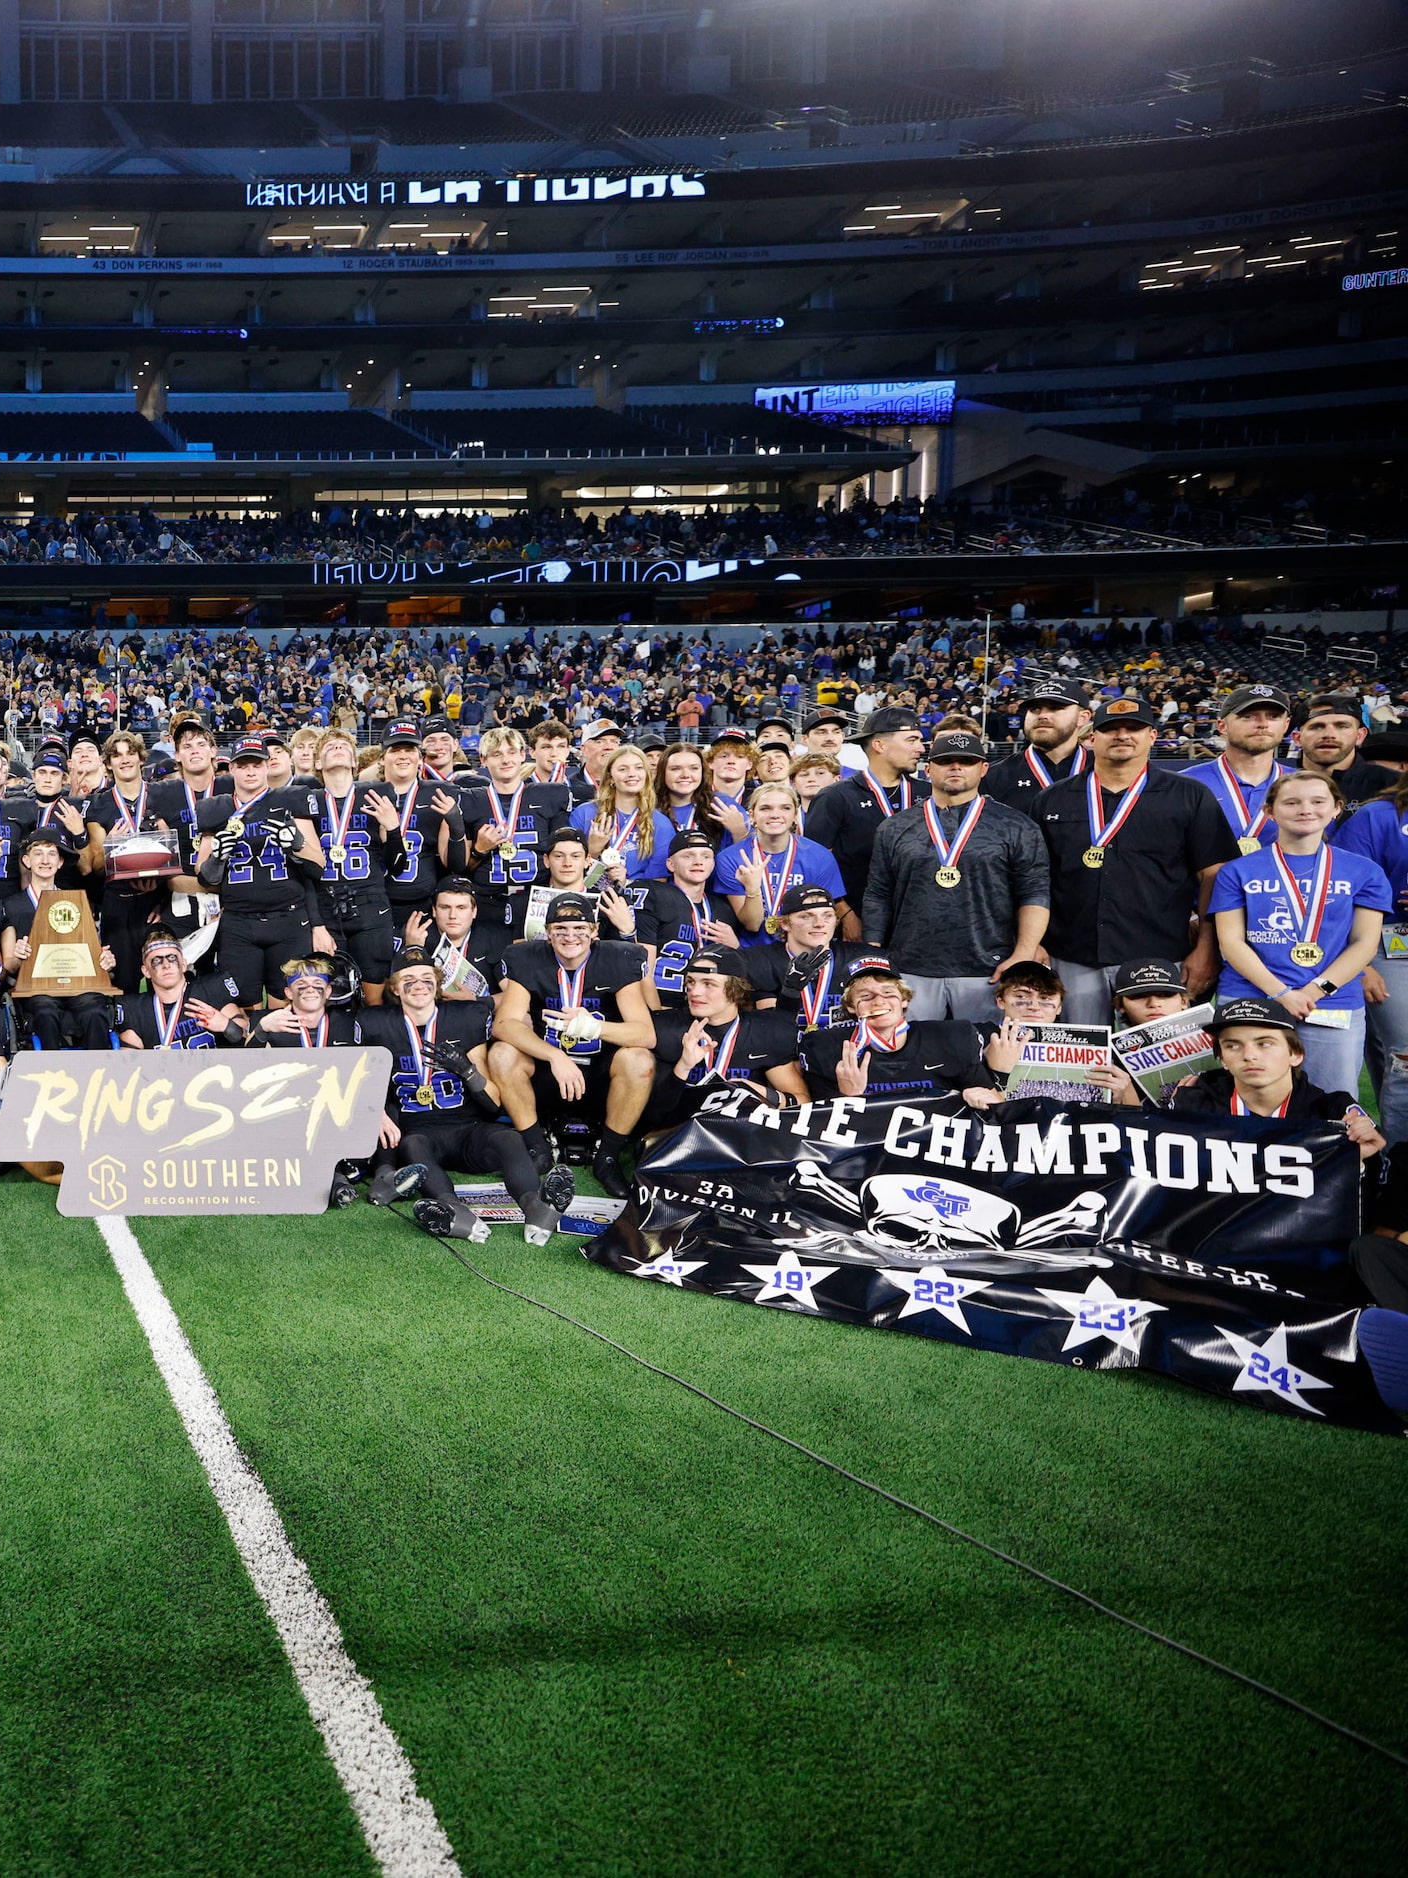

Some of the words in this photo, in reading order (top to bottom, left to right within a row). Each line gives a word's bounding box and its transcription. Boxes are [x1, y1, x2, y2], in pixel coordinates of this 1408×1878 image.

[92, 260, 106, 271] 43
[112, 260, 135, 271] DON
[138, 260, 183, 271] PERKINS
[343, 259, 353, 270] 12
[359, 258, 395, 269] ROGER
[398, 257, 452, 269] STAUBACH
[635, 252, 655, 263] LEE
[658, 252, 678, 262] ROY
[683, 250, 726, 262] JORDAN
[227, 840, 290, 884] 24
[320, 830, 372, 882] 16
[1042, 1036, 1089, 1044] FOOTBALL
[1020, 1045, 1045, 1062] ATE
[1046, 1045, 1108, 1066] CHAMPS!
[1125, 1046, 1166, 1072] STATE
[17, 1066, 176, 1152] RING
[158, 1051, 373, 1153] SZN
[391, 1069, 464, 1112] 20
[699, 1090, 867, 1148] STATE
[883, 1105, 1314, 1198] CHAMPIONS
[143, 1158, 301, 1187] SOUTHERN
[144, 1196, 232, 1205] RECOGNITION
[235, 1196, 262, 1205] INC.
[638, 1185, 756, 1219] DIVISION
[697, 1180, 735, 1199] 3A
[772, 1270, 812, 1291] 19'
[914, 1278, 966, 1308] 22'
[1078, 1299, 1136, 1332] 23'
[1246, 1350, 1301, 1394] 24'
